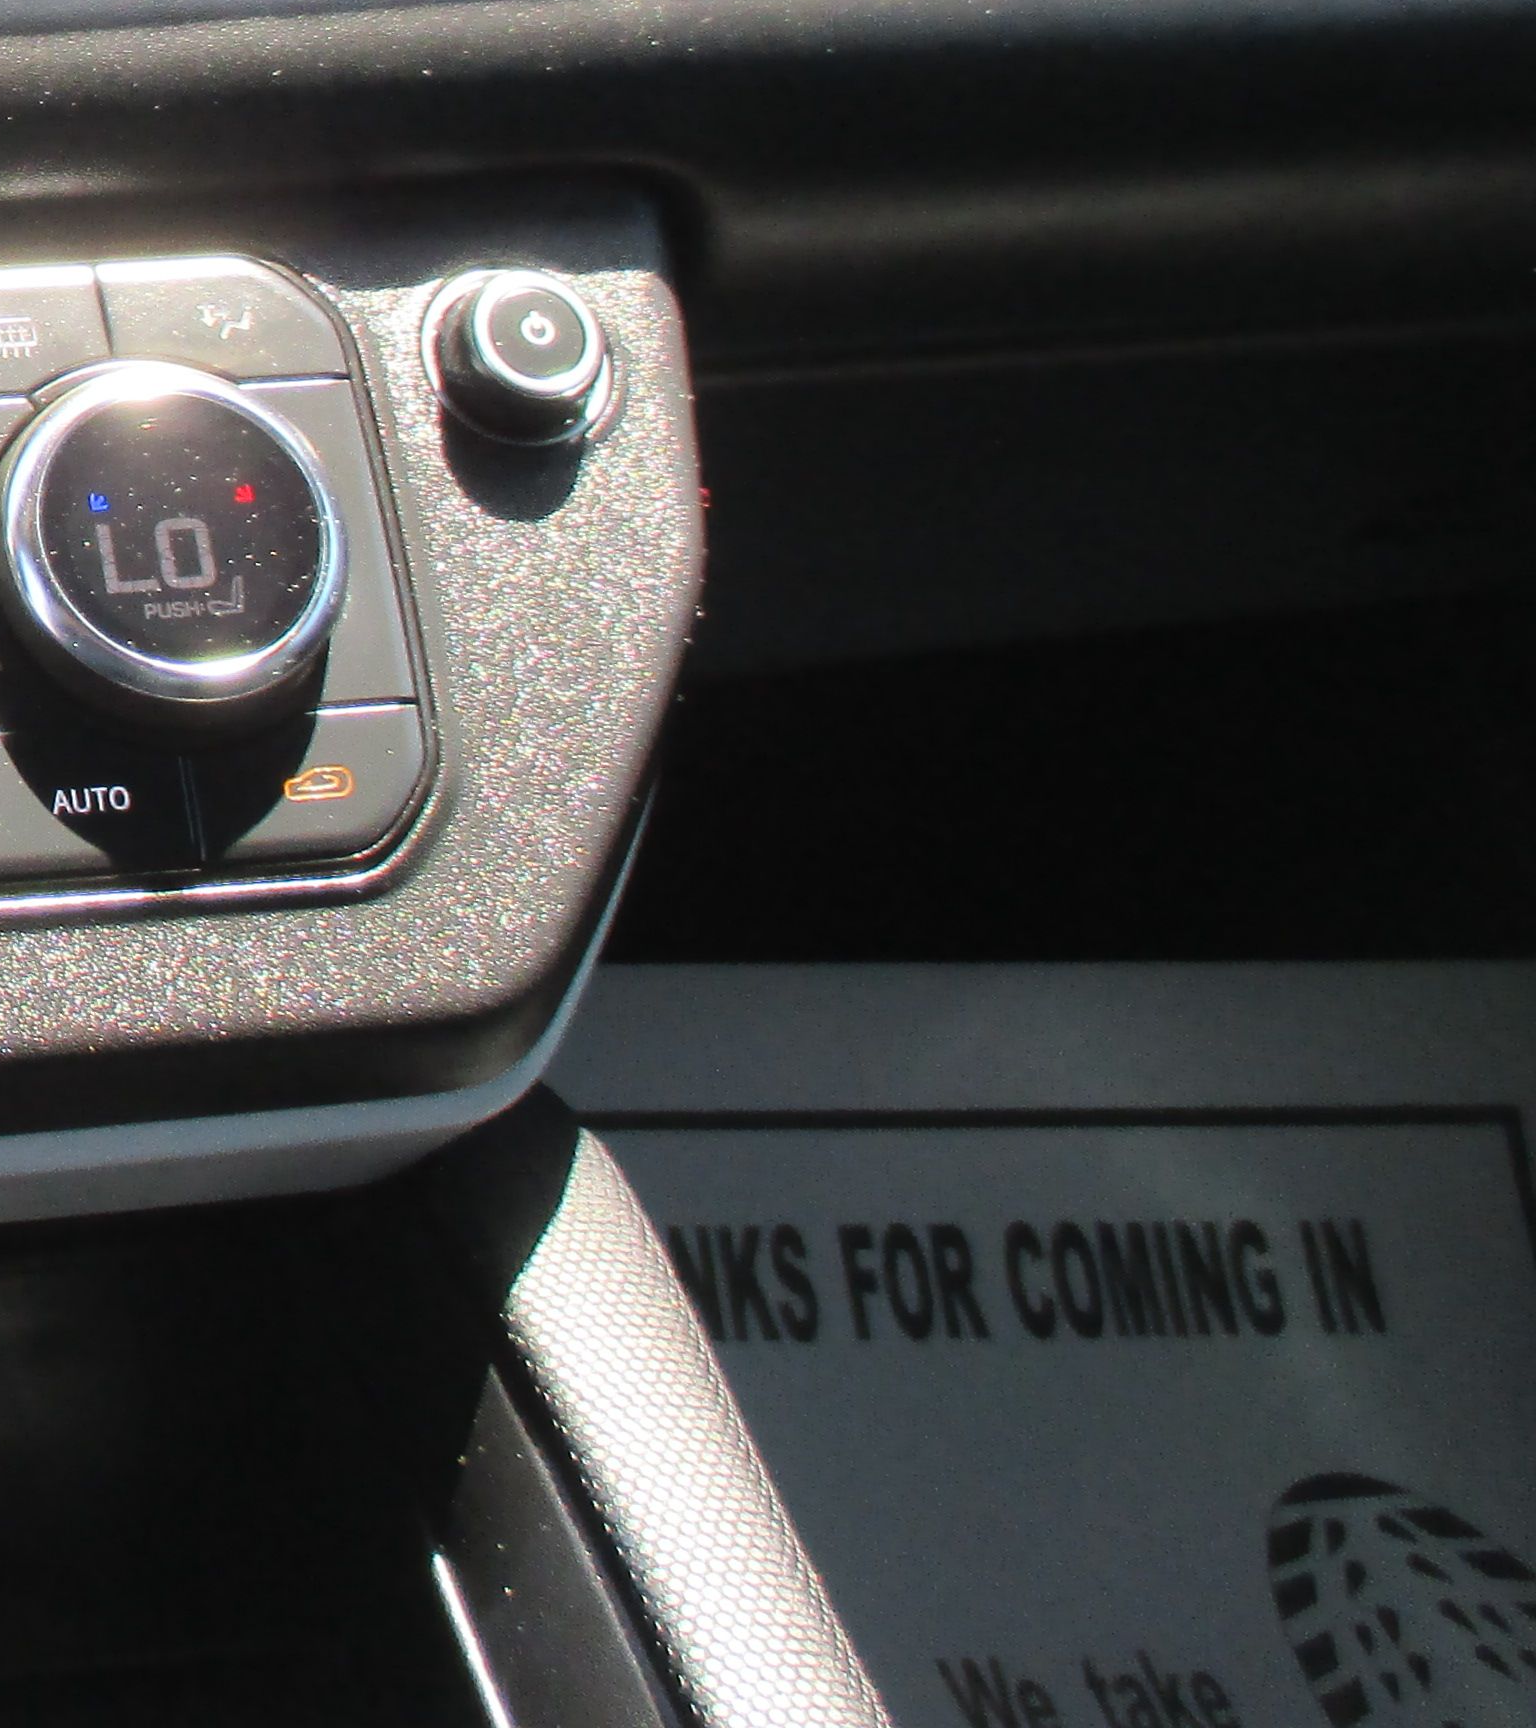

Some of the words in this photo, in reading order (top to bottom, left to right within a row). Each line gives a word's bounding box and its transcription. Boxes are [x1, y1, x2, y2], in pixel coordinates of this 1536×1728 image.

[96, 517, 218, 594] LO
[143, 600, 201, 621] PUSH
[52, 784, 131, 816] AUTO
[668, 1222, 820, 1345] NKS
[838, 1221, 991, 1343] FOR
[1002, 1218, 1289, 1341] COMING
[1297, 1217, 1390, 1336] IN
